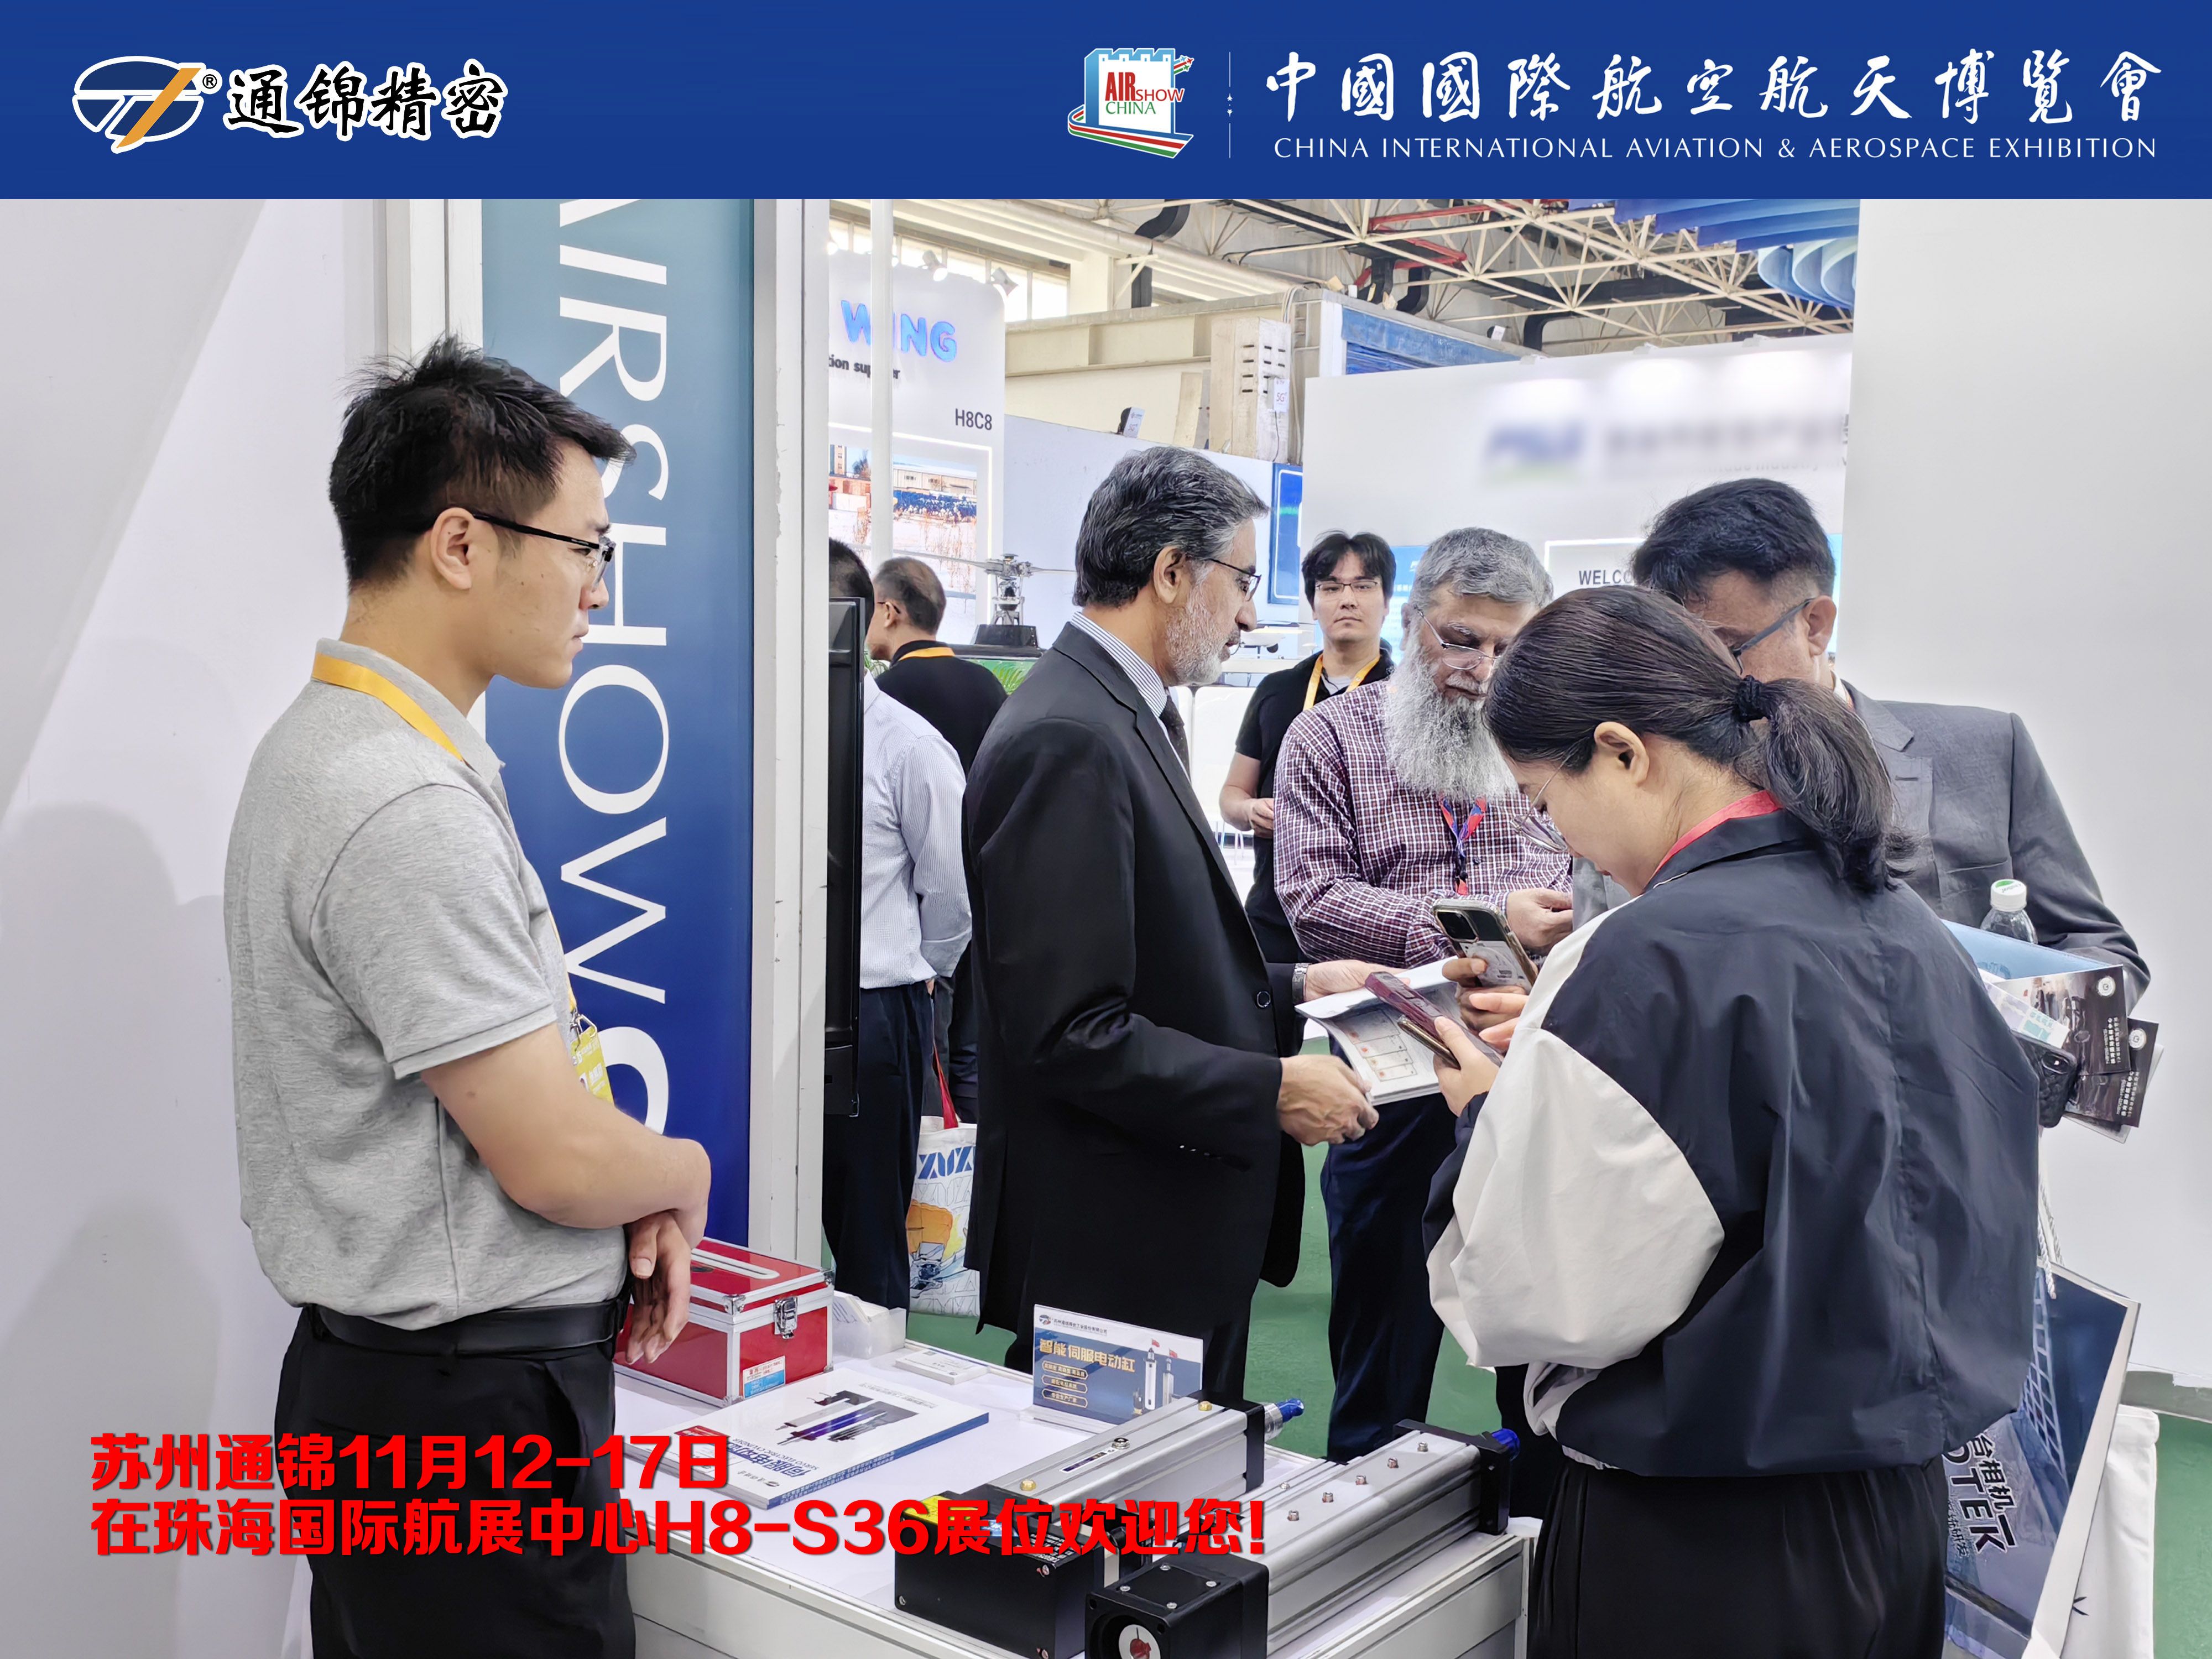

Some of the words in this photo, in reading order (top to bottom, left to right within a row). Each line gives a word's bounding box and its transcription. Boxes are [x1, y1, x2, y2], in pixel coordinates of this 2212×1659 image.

[841, 300, 957, 362] WNG
[955, 408, 992, 430] H8C8
[1039, 1338, 1135, 1373] 智能伺服电动缸
